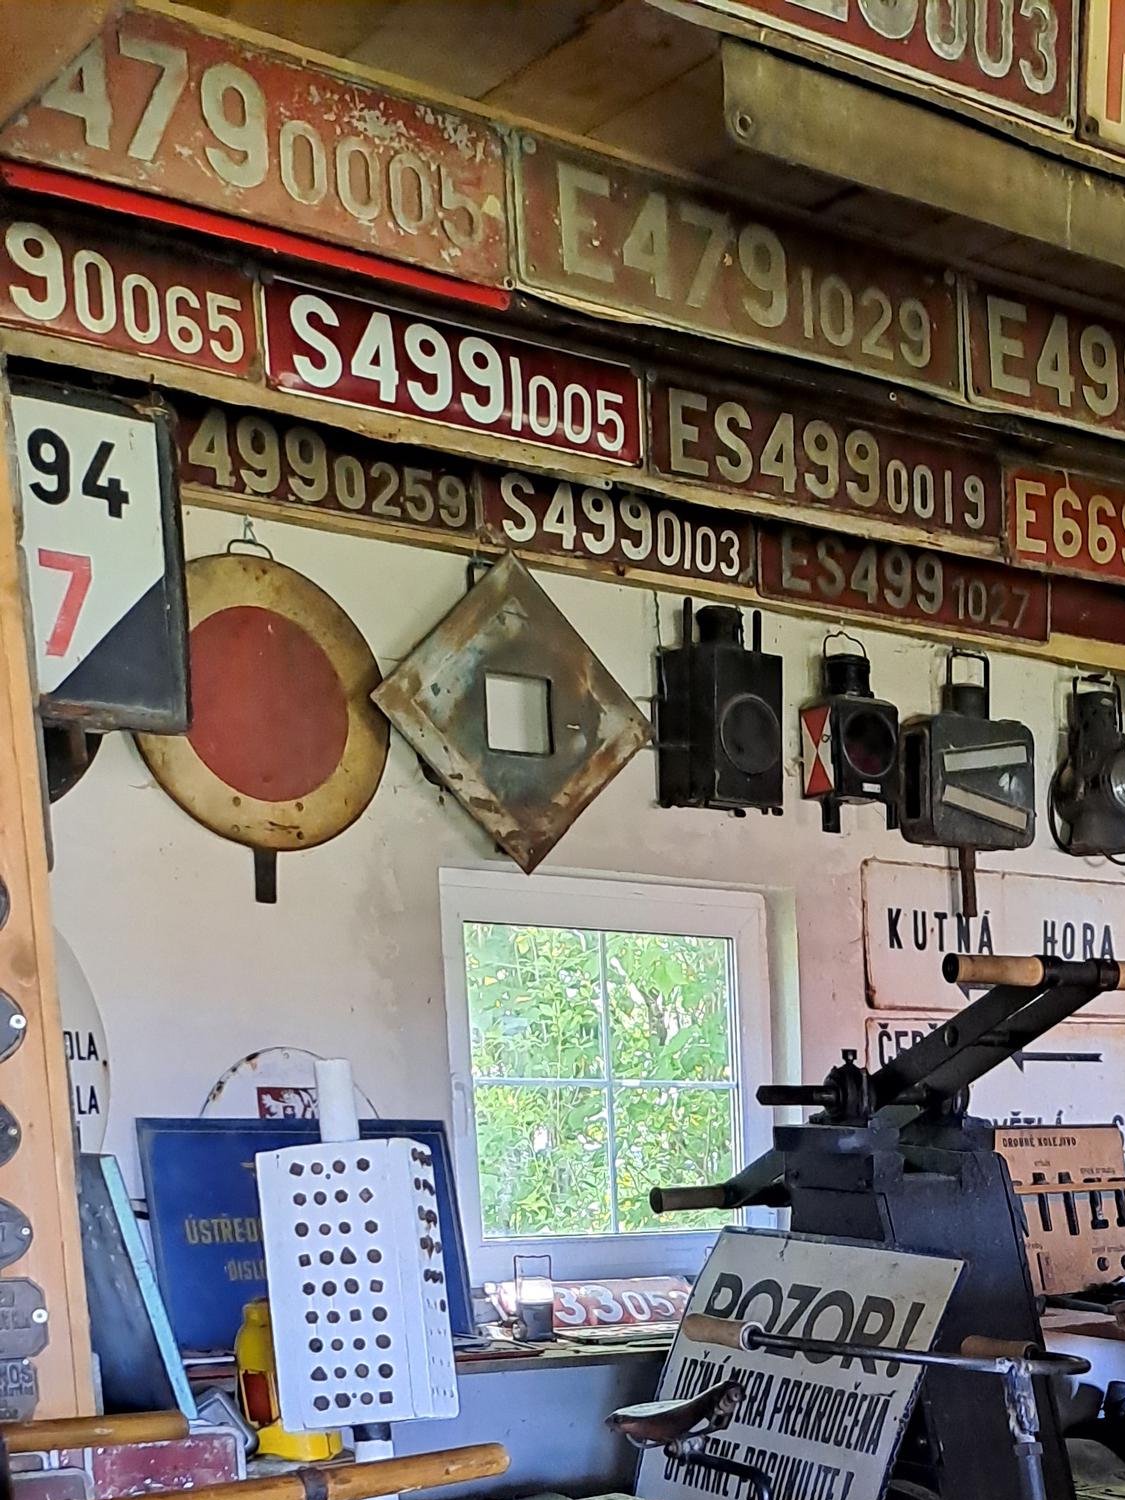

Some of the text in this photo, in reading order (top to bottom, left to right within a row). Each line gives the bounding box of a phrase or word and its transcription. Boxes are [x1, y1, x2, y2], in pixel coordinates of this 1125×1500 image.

[27, 429, 130, 520] 94
[37, 548, 92, 658] 7
[887, 908, 1115, 962] KUTNÁ HORA
[703, 1272, 925, 1378] POZOR!
